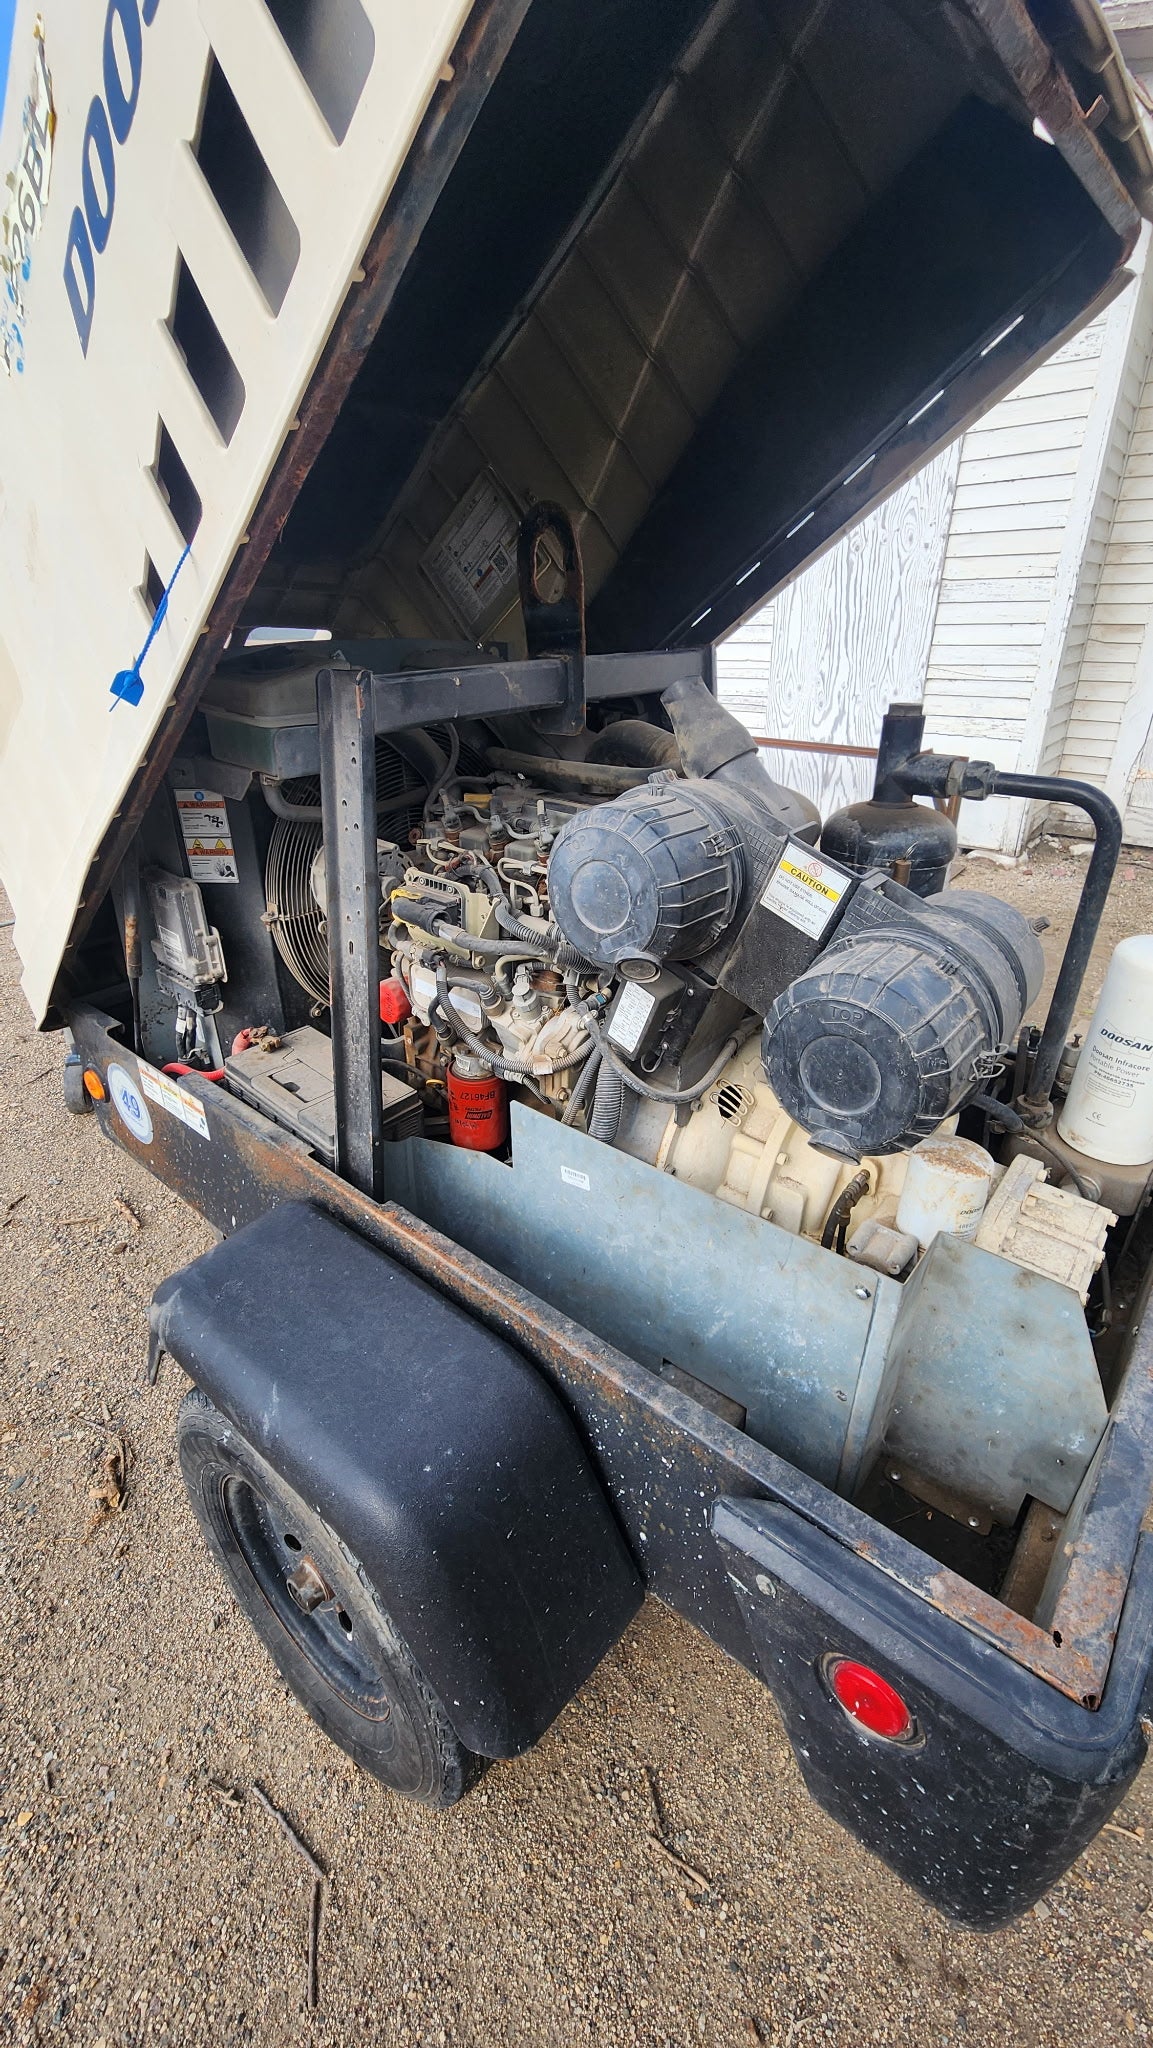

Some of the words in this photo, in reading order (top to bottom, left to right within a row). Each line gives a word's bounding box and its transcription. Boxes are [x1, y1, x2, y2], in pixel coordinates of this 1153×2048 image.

[63, 0, 160, 360] DOO
[789, 867, 829, 895] CAUTION
[830, 1005, 863, 1021] TOP
[1100, 1028, 1153, 1051] DOOSAN
[1090, 1052, 1115, 1071] Portable
[1116, 1066, 1140, 1078] Power
[1092, 1045, 1114, 1062] Doosan
[1115, 1056, 1151, 1072] Infracore
[122, 1090, 140, 1119] 49
[460, 1090, 496, 1100] BF46127
